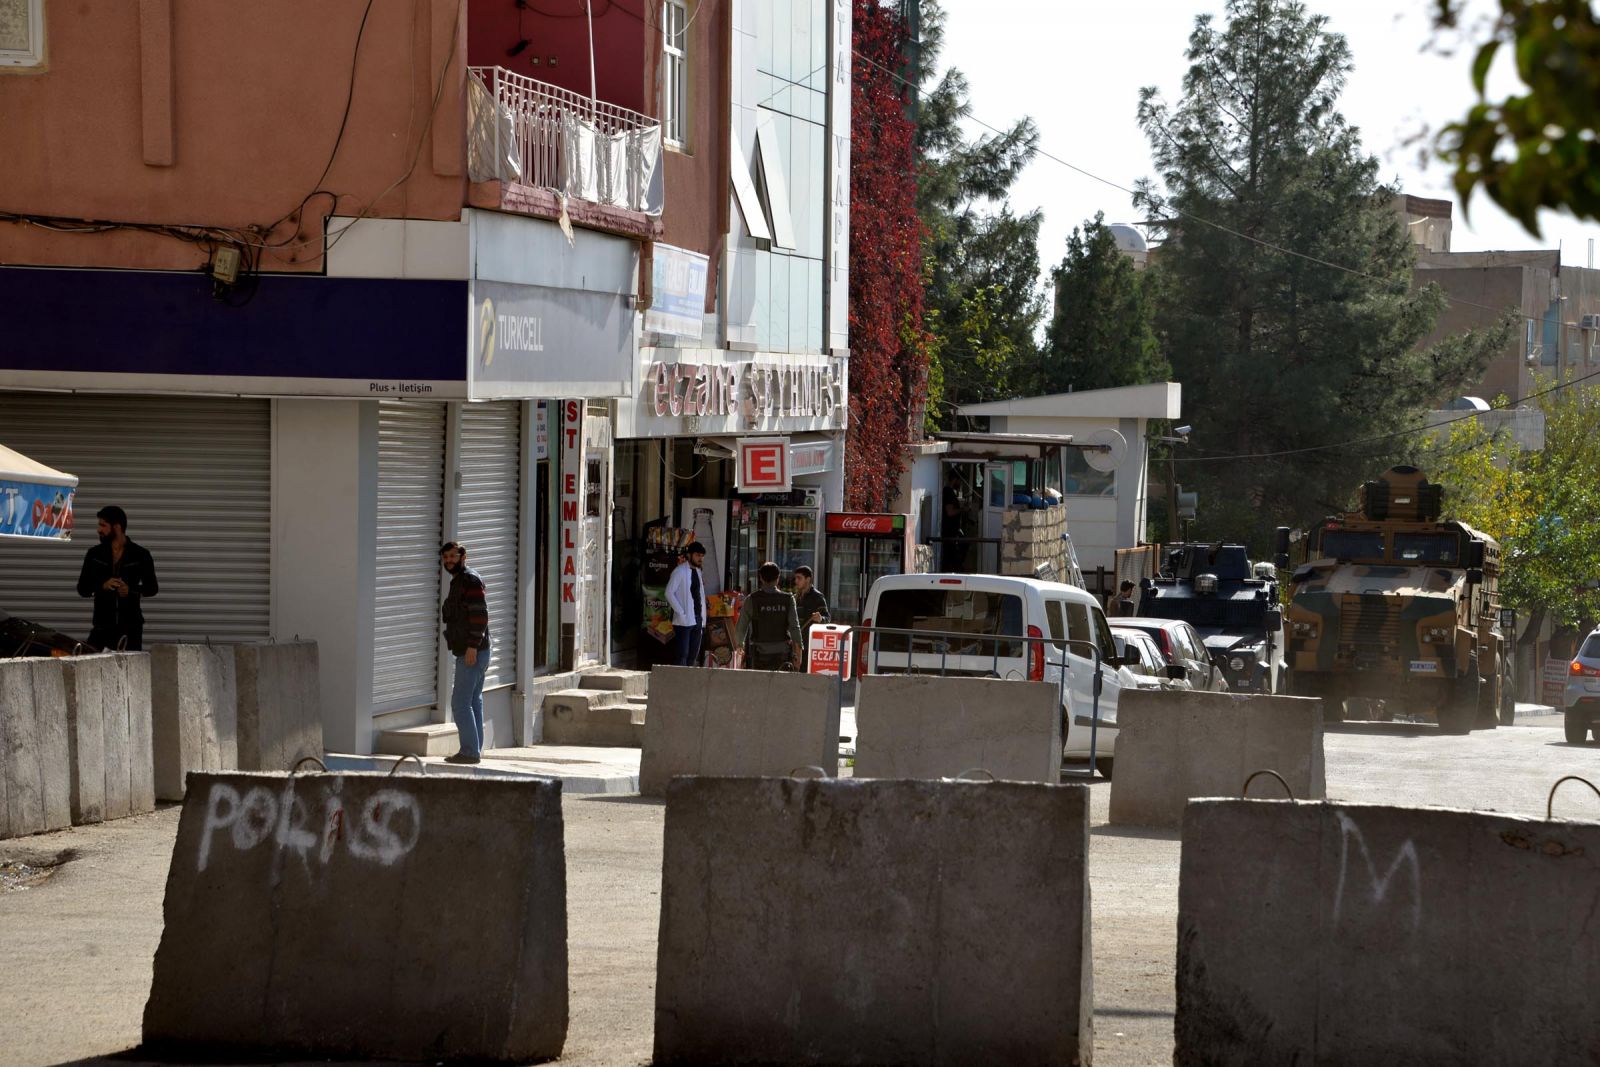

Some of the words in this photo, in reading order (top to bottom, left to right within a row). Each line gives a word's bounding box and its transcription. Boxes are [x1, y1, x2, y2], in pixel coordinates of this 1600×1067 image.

[499, 315, 543, 351] TURKCELL
[370, 383, 389, 391] Plus
[655, 362, 738, 416] eczane
[751, 450, 777, 480] E
[563, 475, 578, 602] EMLAK
[826, 636, 835, 648] E
